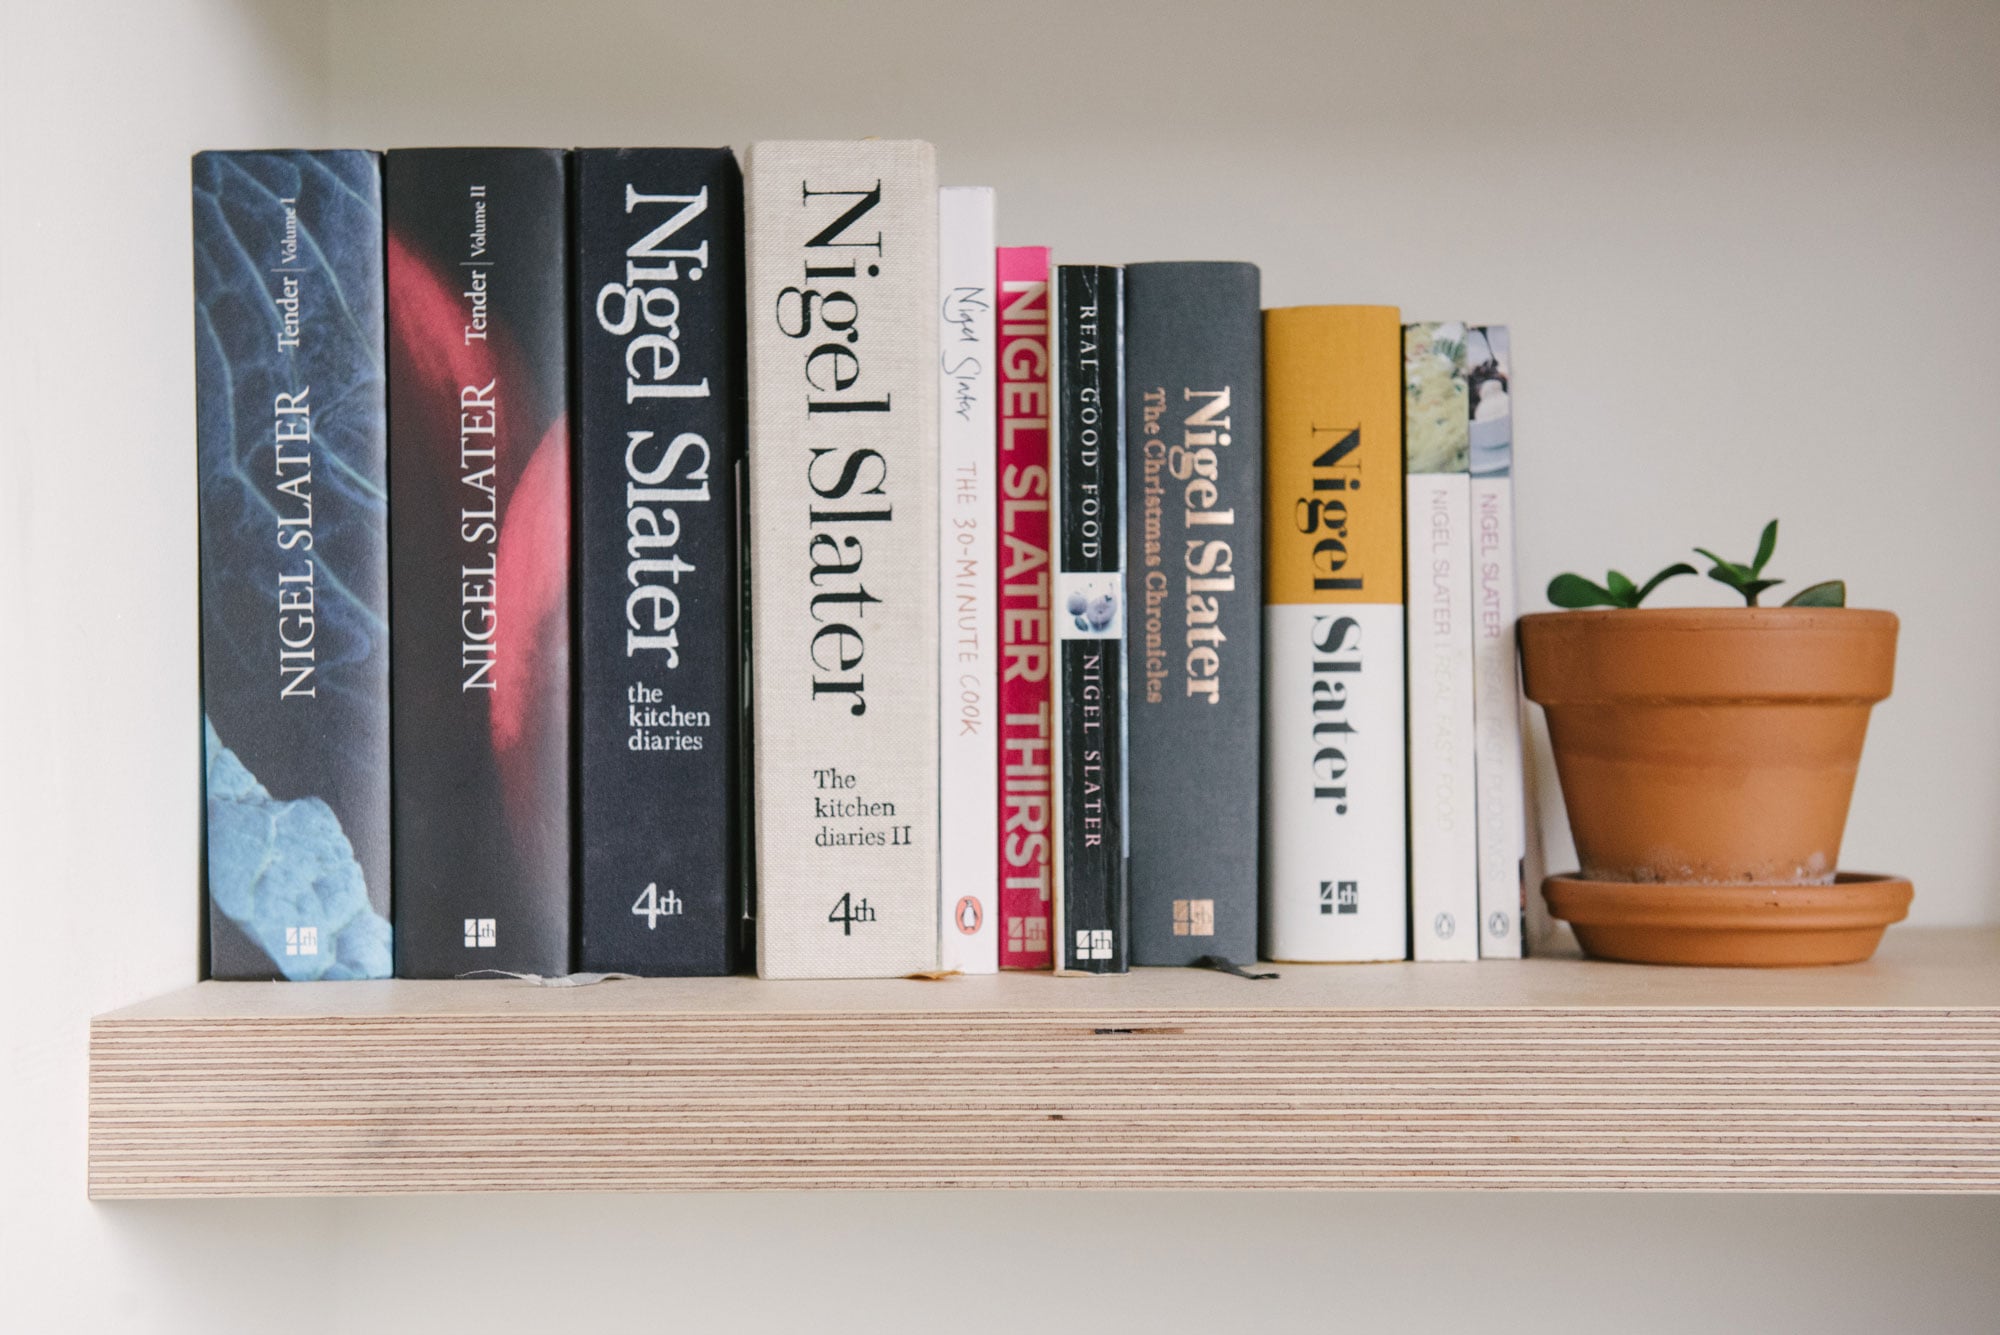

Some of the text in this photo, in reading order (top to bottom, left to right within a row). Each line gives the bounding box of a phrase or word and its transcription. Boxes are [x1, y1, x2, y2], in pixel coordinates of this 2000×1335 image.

[281, 207, 297, 264] Volume
[464, 185, 488, 346] Tender Volume II
[277, 276, 300, 352] Tender
[942, 286, 989, 422] Nigel Slater
[596, 183, 711, 669] Nigel Slater
[776, 178, 893, 717] Nigel Slater
[1079, 304, 1100, 559] REAL GOOD FOOD
[275, 385, 316, 700] NIGEL SLATER
[461, 379, 497, 693] NIGEL SLATER
[1143, 387, 1168, 704] The Christmas Chronicles
[1168, 386, 1236, 705] Nigel Slater
[1431, 489, 1450, 554] NIGEL
[1480, 493, 1499, 557] NIGEL
[953, 462, 982, 737] THE 30-MINUTE COOK
[1002, 280, 1050, 900] NIGEL SLATER THIRST
[1296, 422, 1363, 815] Nigel Slater
[1433, 559, 1452, 636] SLATER
[1481, 563, 1500, 639] SLATER
[628, 682, 663, 704] the
[628, 705, 711, 727] kitchen
[628, 730, 703, 750] diaries
[1083, 654, 1101, 848] NIGEL SLATER
[813, 768, 856, 790] The
[814, 797, 896, 818] kitchen
[1436, 772, 1455, 831] FOOD
[814, 825, 912, 847] diaries II
[631, 882, 683, 930] 4th
[828, 892, 876, 936] 4th
